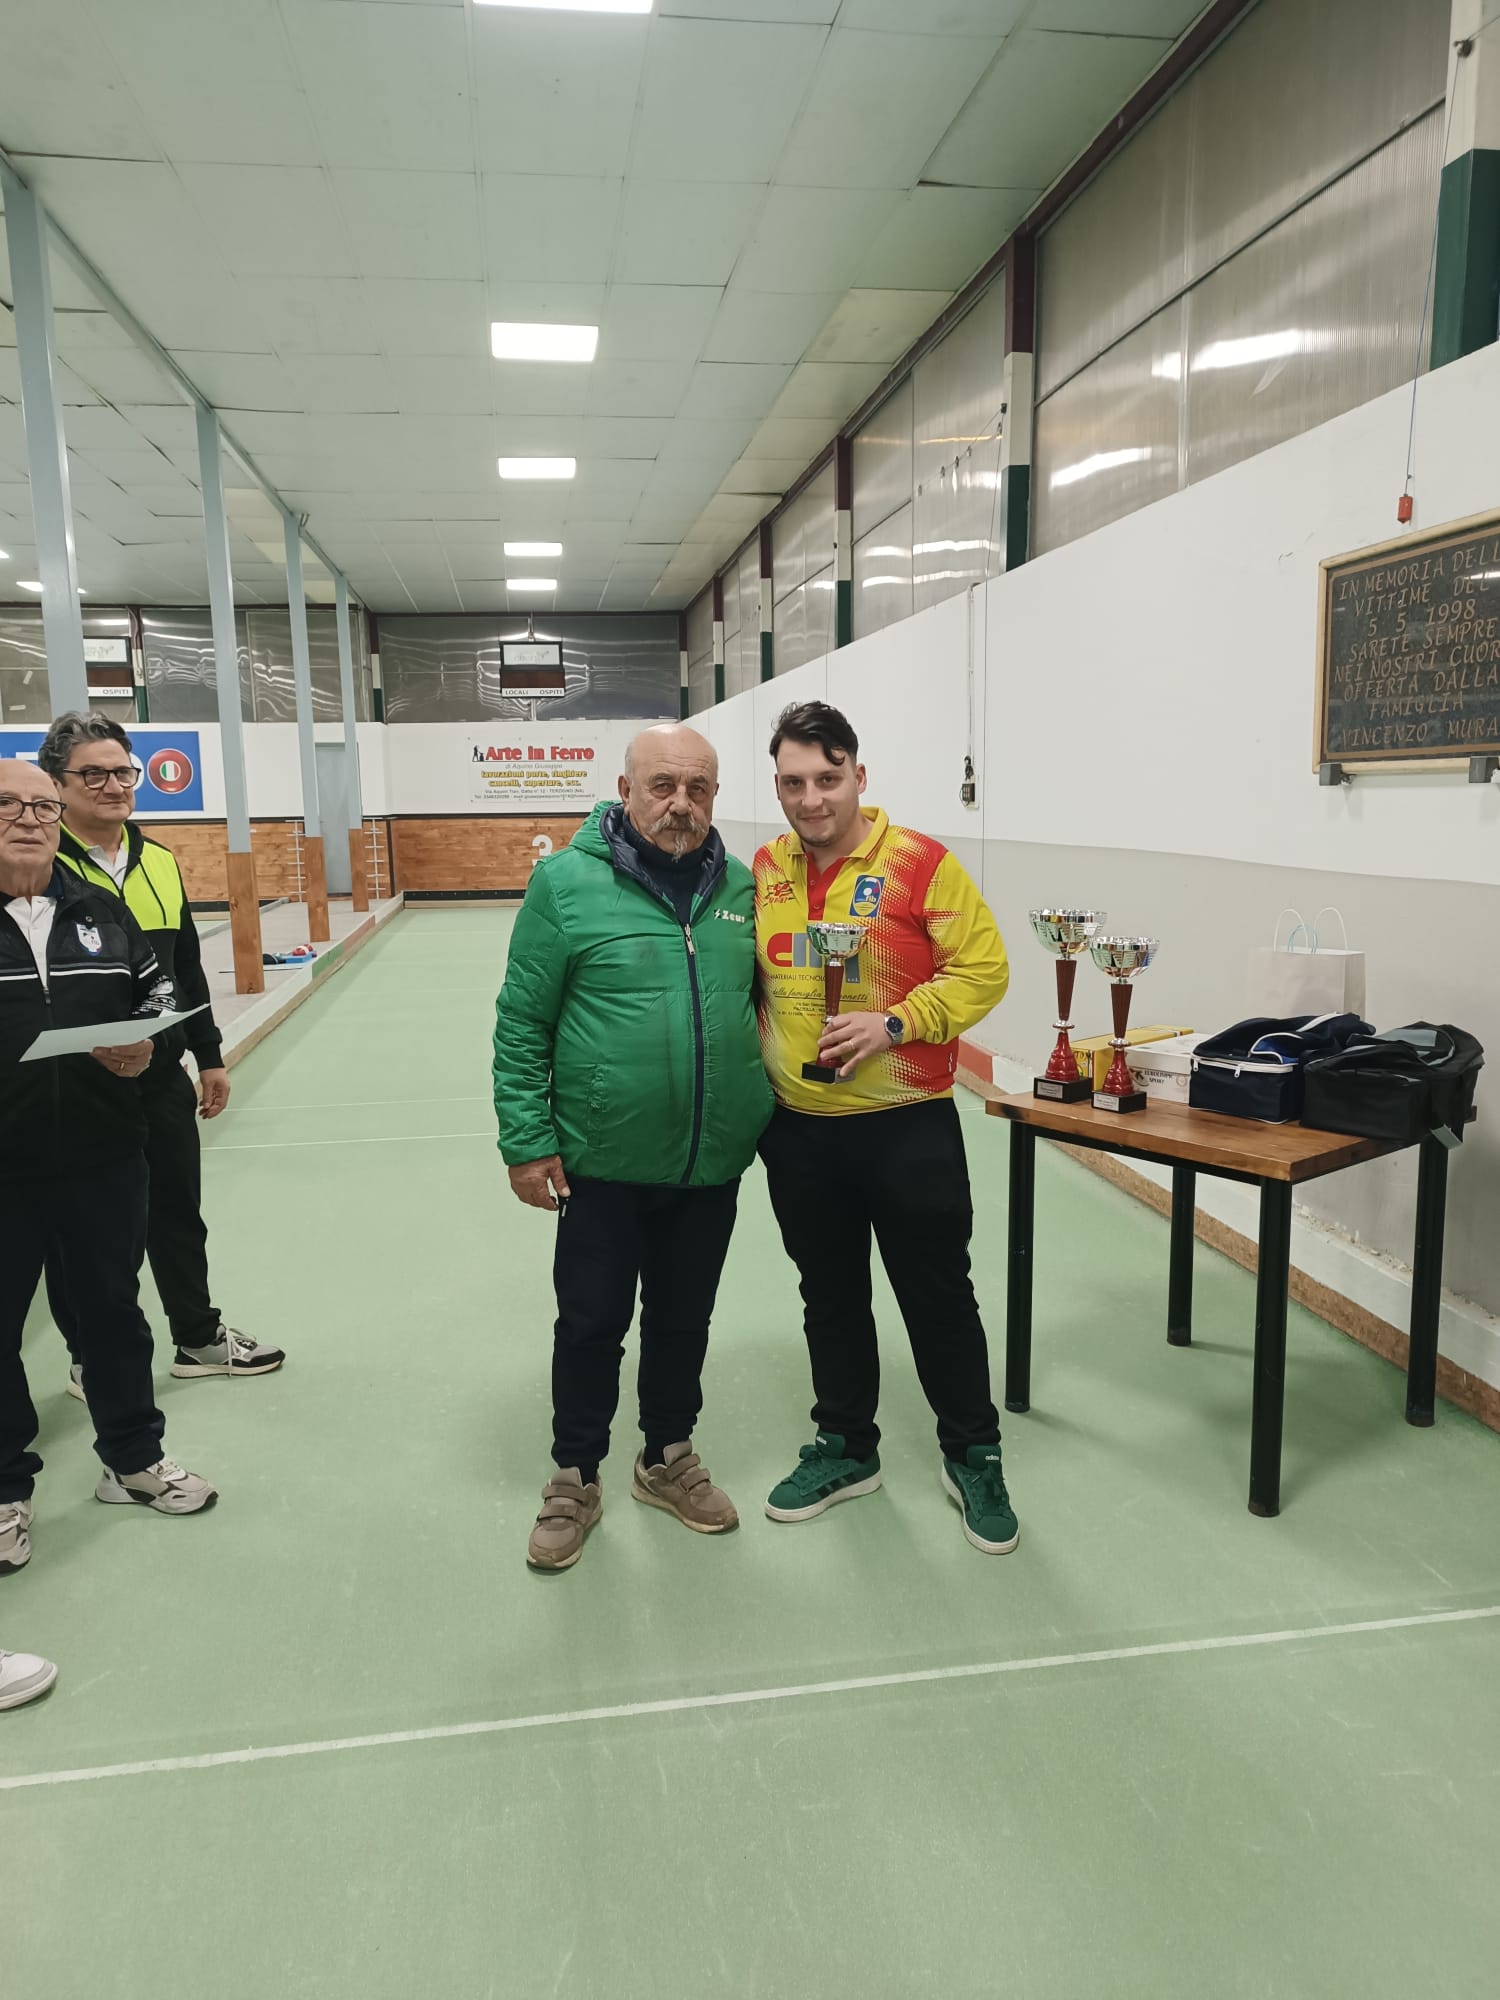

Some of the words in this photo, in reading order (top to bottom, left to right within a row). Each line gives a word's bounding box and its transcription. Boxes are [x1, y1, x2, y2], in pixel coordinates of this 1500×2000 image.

[1340, 581, 1360, 600] IN
[1365, 557, 1444, 593] MEMORIA
[1452, 542, 1500, 572] DELL
[1355, 583, 1432, 617] VITTIME
[1367, 617, 1379, 637] 5
[1395, 611, 1407, 633] 5
[1424, 598, 1477, 627] 1998
[1349, 633, 1411, 663] SARETE
[1422, 617, 1499, 649] SEMPRE
[1334, 663, 1364, 683] NEI
[1370, 649, 1438, 680] NOSTRI
[1450, 640, 1500, 667] CUOR
[1344, 674, 1419, 702] OFFERTA
[1433, 663, 1498, 692] DALLA
[1369, 690, 1464, 721] FAMIGLIA
[1343, 722, 1428, 747] VINCENZO
[1448, 716, 1499, 739] MURA
[485, 746, 522, 760] Arte
[550, 746, 595, 760] Ferro
